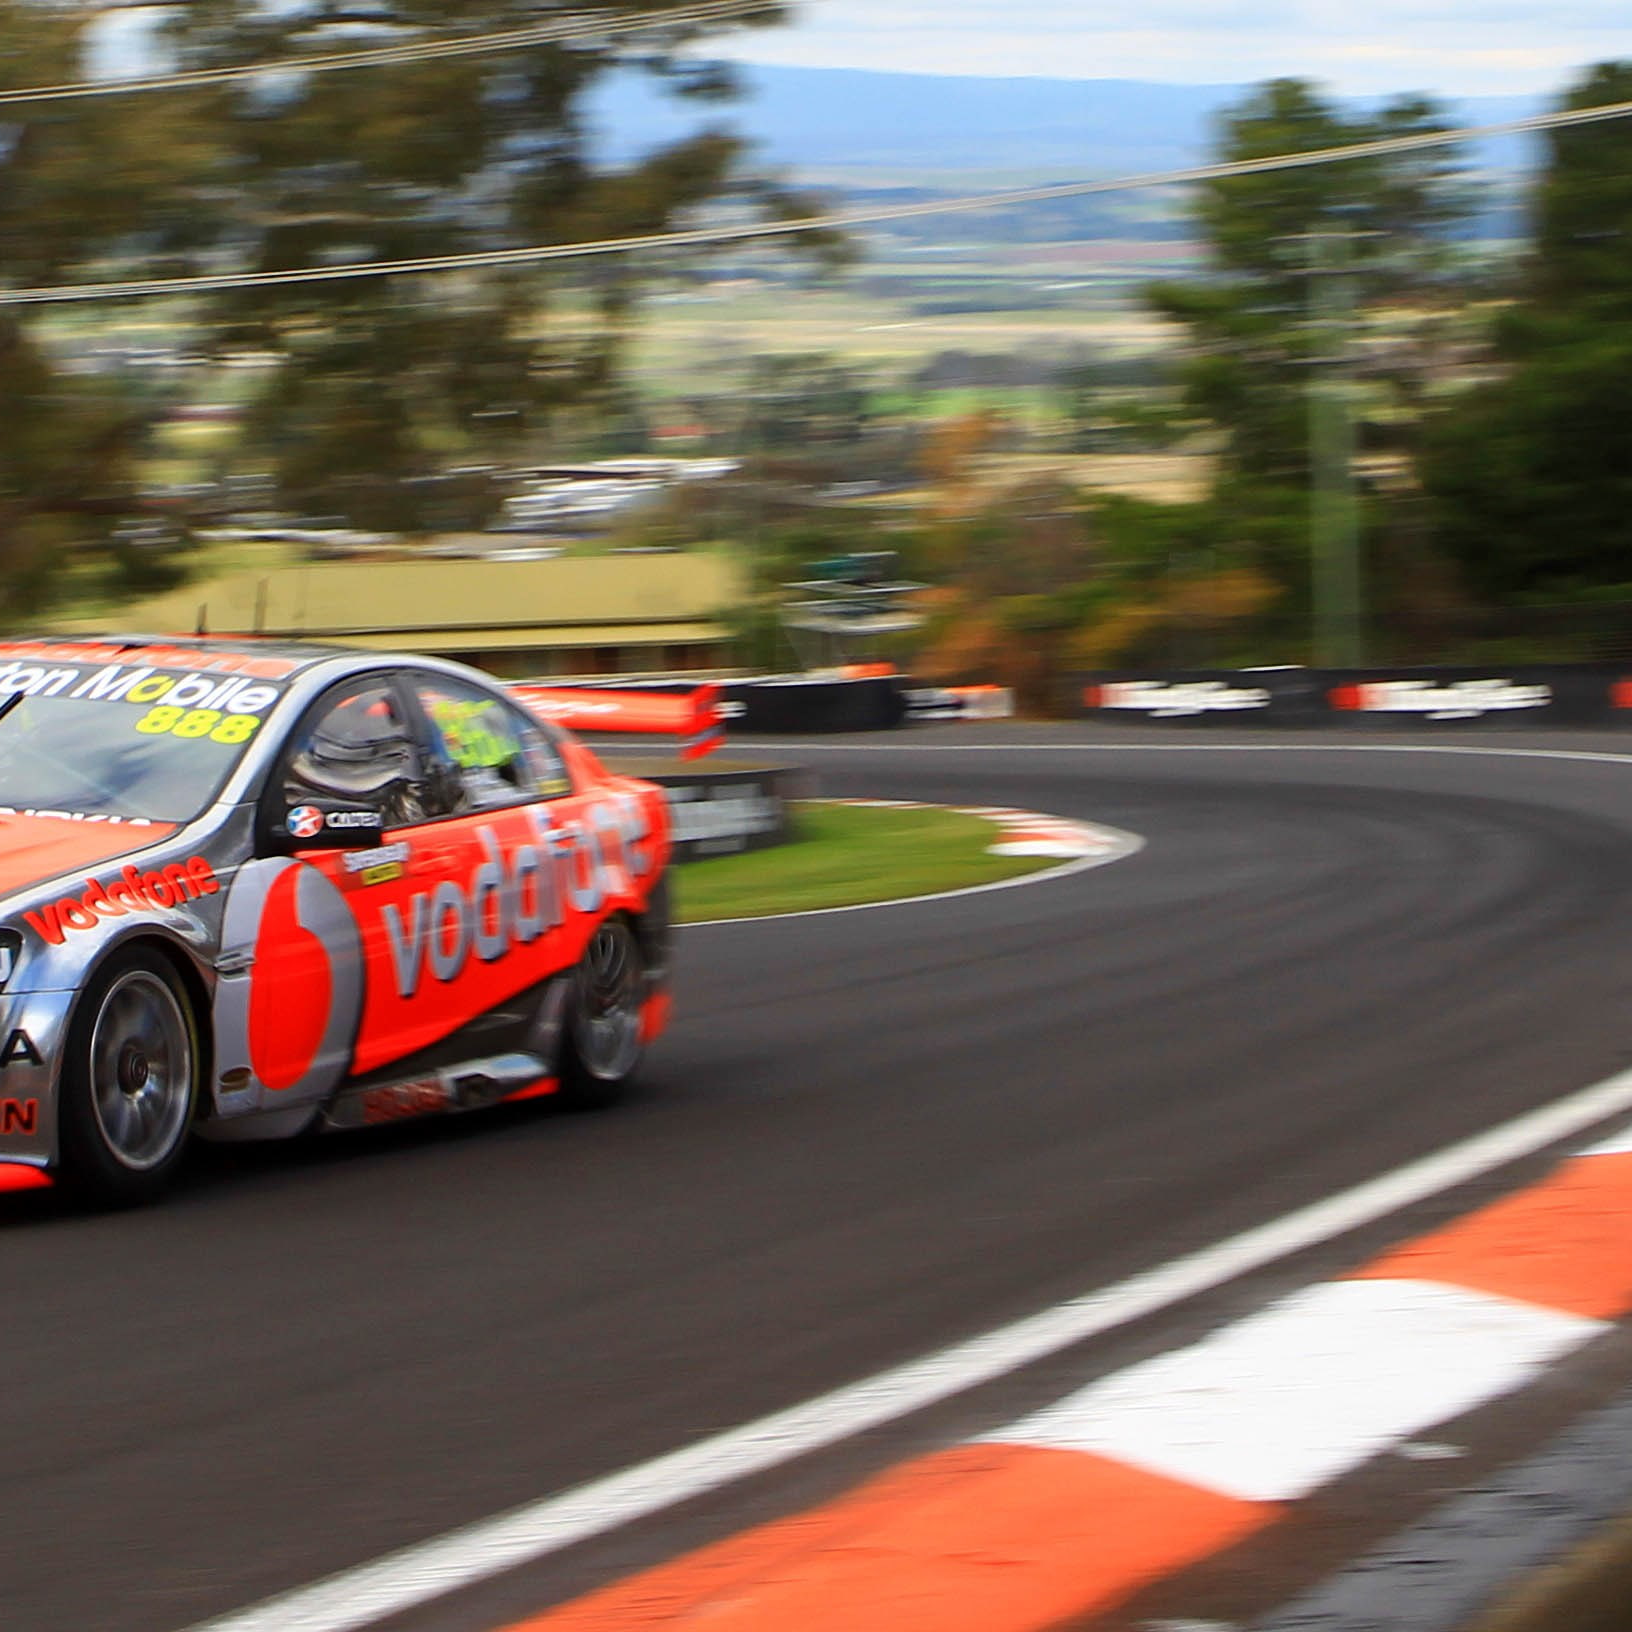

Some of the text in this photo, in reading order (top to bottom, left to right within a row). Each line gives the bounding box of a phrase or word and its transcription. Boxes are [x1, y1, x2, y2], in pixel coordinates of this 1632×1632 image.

[71, 667, 280, 714] Mobile
[135, 705, 261, 744] 888
[23, 856, 220, 945] vodafone
